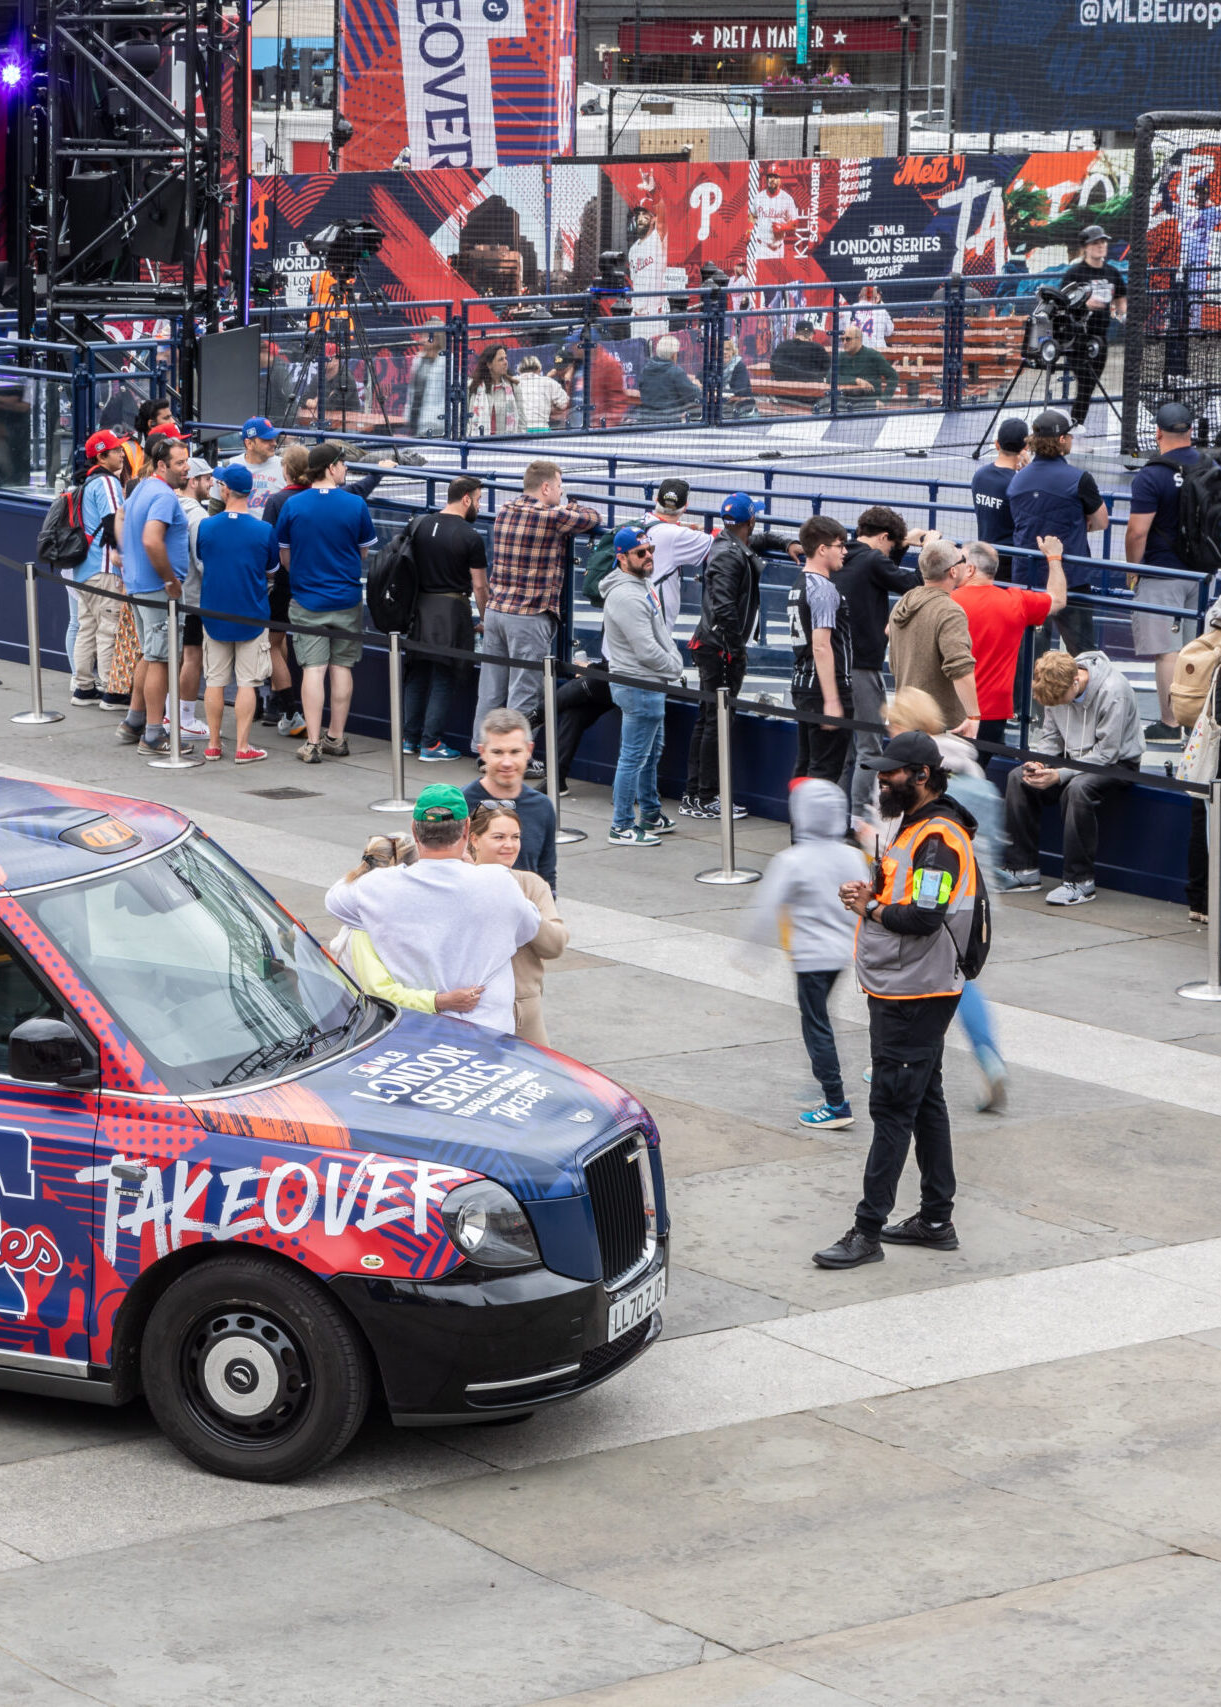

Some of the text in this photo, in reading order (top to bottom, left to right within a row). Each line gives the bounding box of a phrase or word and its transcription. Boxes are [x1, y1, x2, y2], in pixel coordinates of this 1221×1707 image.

[713, 26, 824, 48] PRET A MANR
[893, 156, 949, 186] Mets
[689, 182, 723, 241] P
[809, 162, 821, 242] SCHWARBER
[794, 207, 811, 259] KYLE
[830, 236, 941, 256] LONDON SERIES
[884, 225, 905, 236] MLB
[273, 257, 320, 272] WORLD
[852, 254, 919, 265] TRAFALGAR SQUARE
[975, 493, 1004, 510] STAFF
[350, 1044, 482, 1104] LONDON
[375, 1050, 409, 1071] MLB
[411, 1060, 513, 1110] SERIES
[453, 1081, 506, 1118] TRAFALGAR
[490, 1081, 555, 1122] TAKEOVER
[75, 1152, 472, 1268] TAKEOVER
[613, 1294, 644, 1335] LL70
